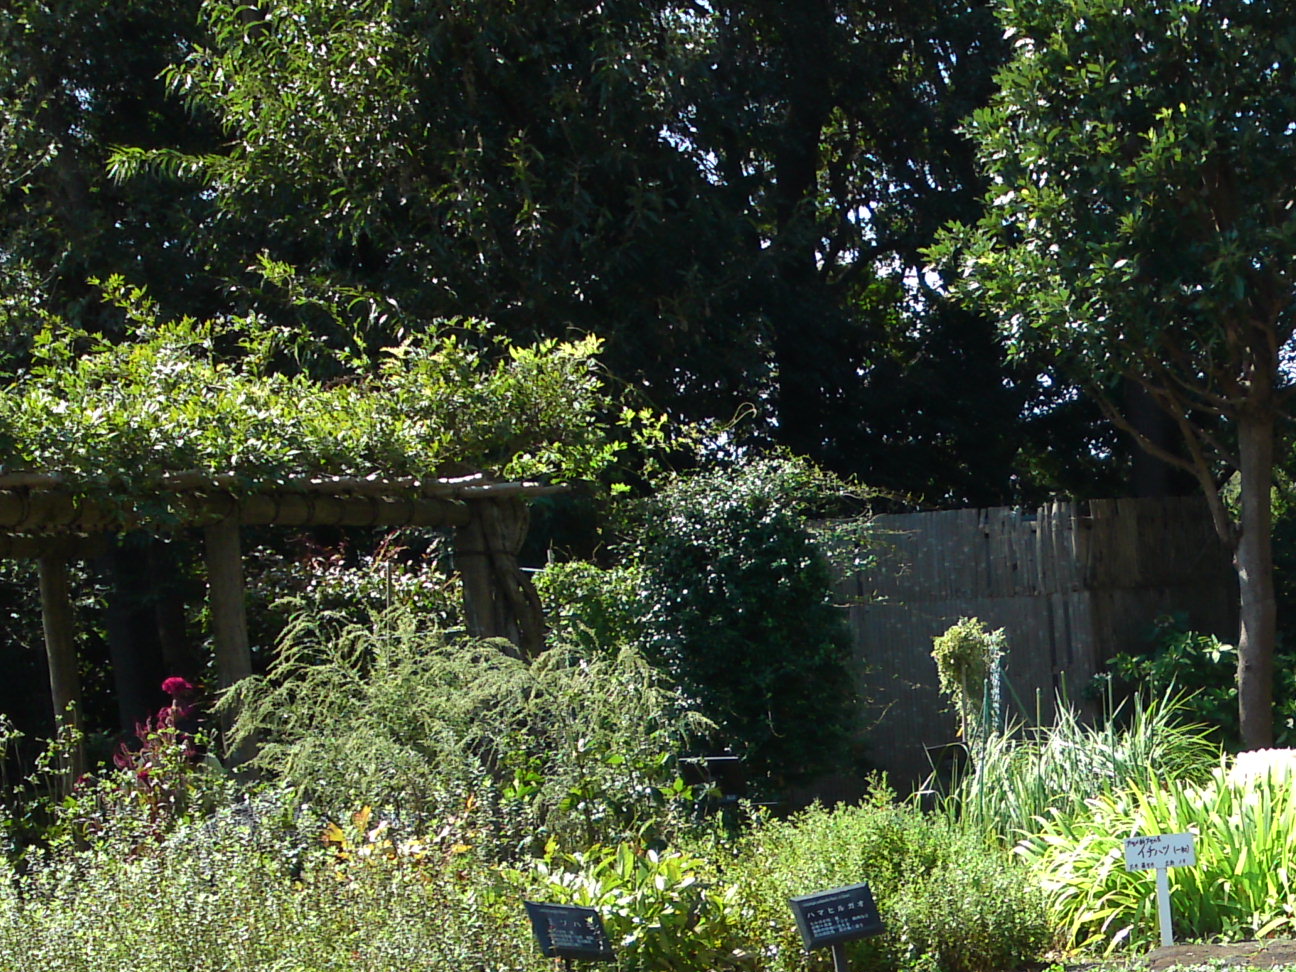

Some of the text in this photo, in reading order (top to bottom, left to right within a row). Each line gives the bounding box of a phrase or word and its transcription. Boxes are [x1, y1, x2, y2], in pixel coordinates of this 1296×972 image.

[1138, 844, 1170, 858] イチハツ
[807, 900, 865, 919] ハマヒルガオ
